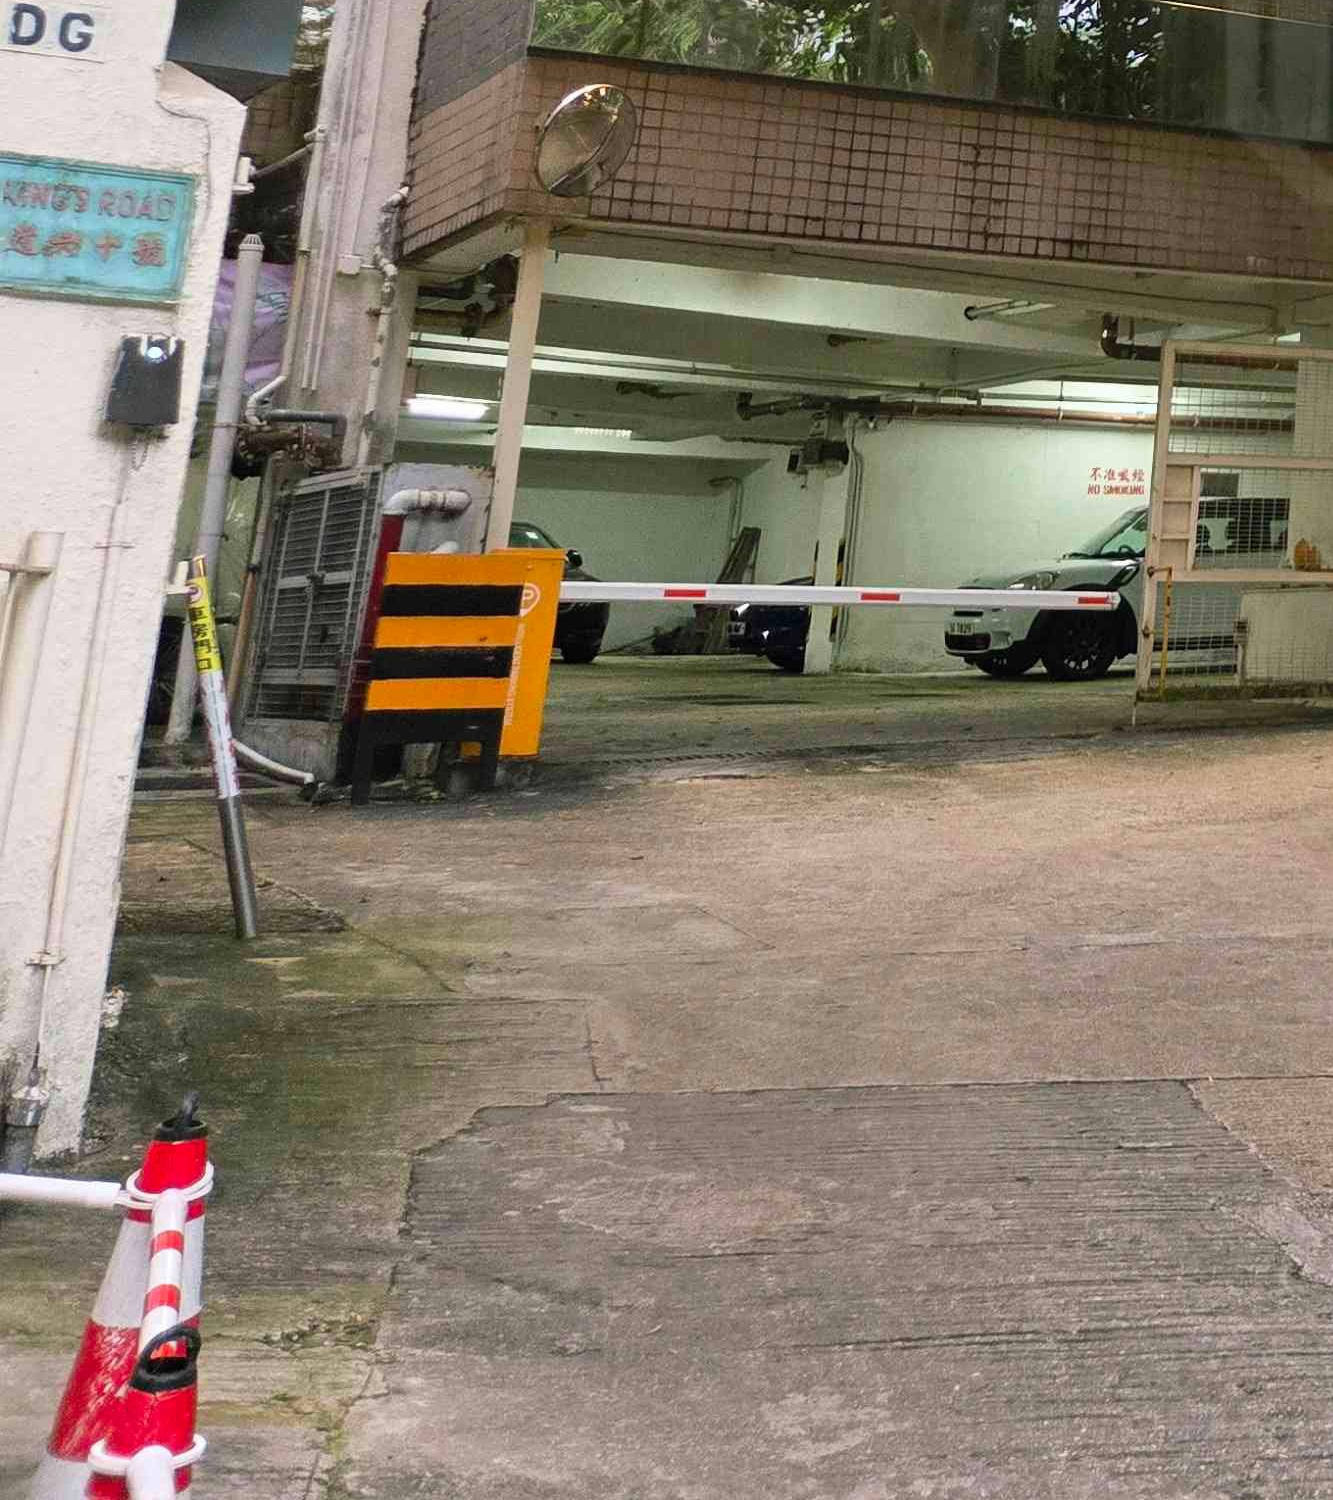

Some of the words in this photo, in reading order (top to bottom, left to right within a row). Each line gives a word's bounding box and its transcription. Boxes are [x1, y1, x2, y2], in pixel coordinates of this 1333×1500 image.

[11, 3, 96, 52] DG
[98, 188, 176, 222] ROAD
[1088, 484, 1100, 495] NO
[1103, 484, 1144, 495] SMOKING
